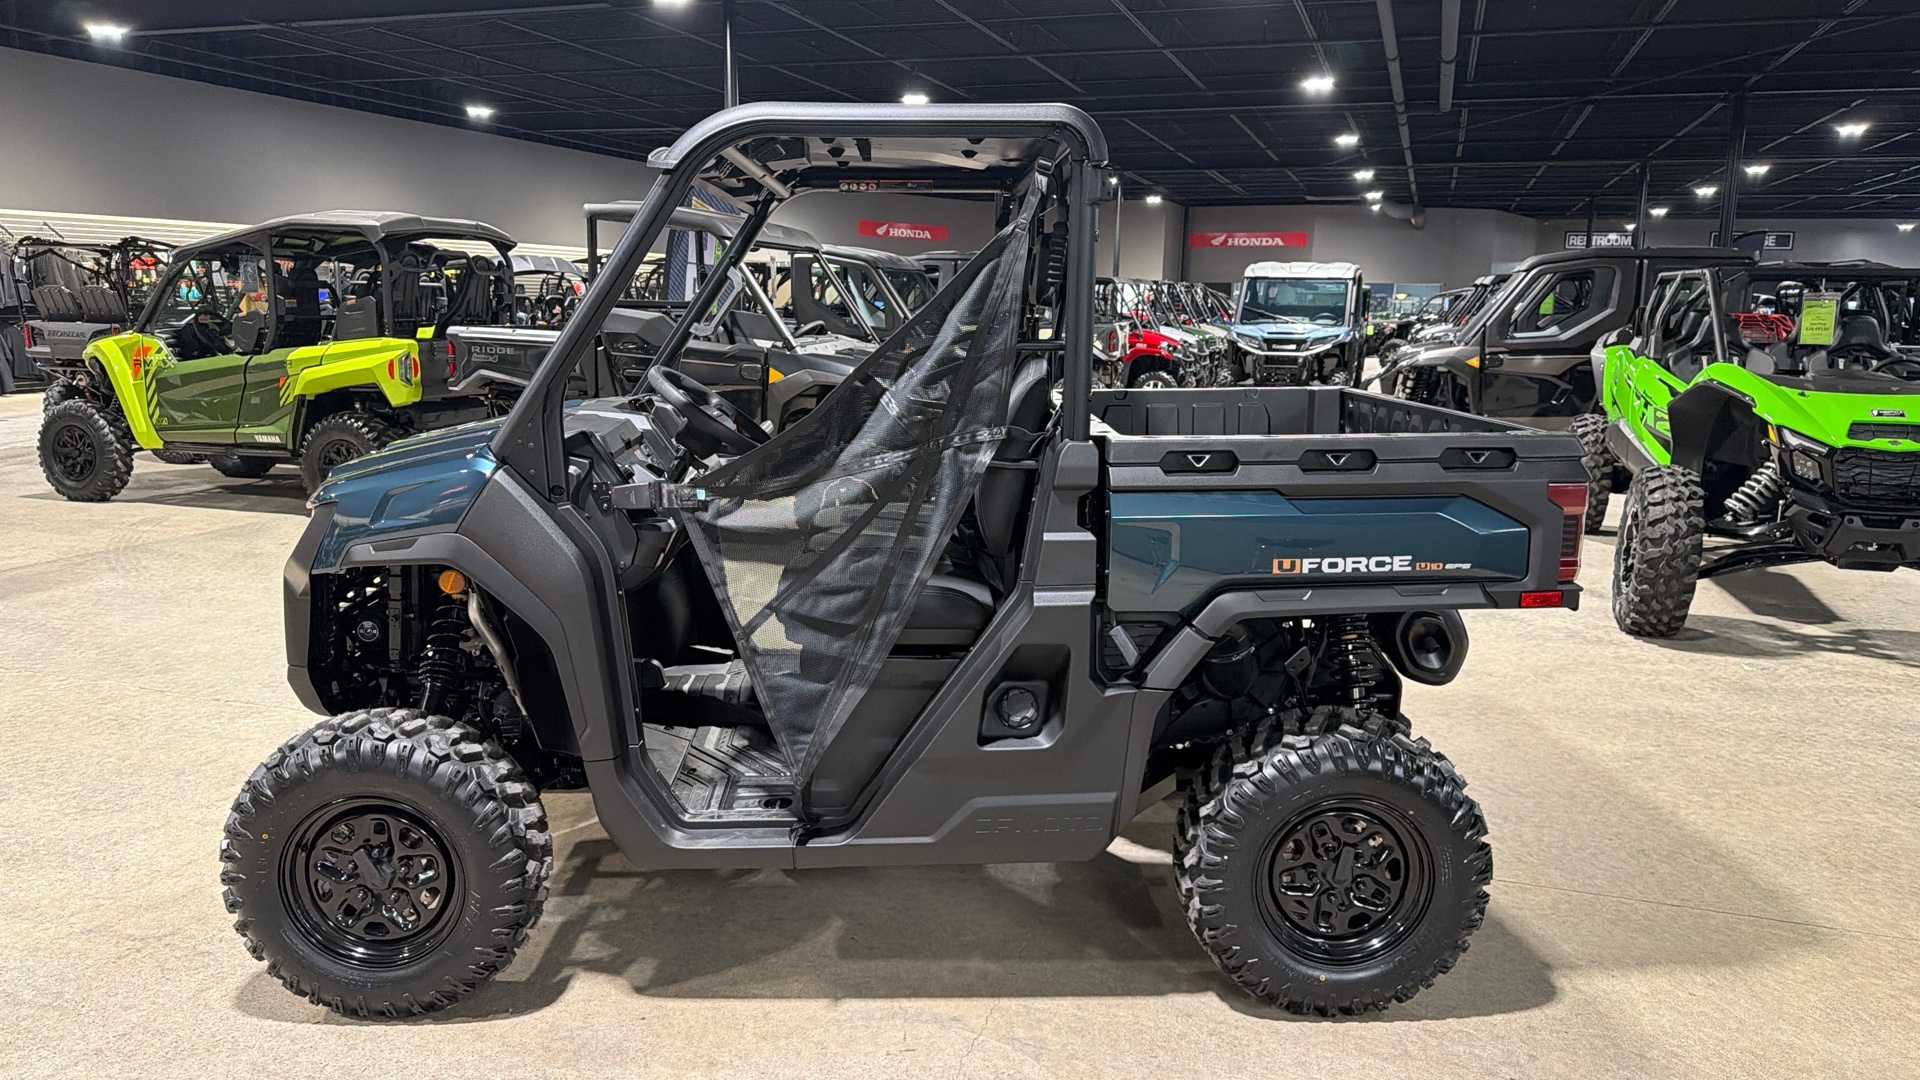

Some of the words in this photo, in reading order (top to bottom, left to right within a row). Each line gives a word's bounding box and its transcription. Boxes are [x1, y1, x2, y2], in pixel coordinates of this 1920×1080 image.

[888, 227, 932, 239] HONDA
[1226, 237, 1284, 246] HONDA
[1568, 235, 1632, 246] RETROOM
[47, 329, 87, 339] HONDA
[471, 345, 515, 354] RIDGE
[253, 434, 282, 444] YAMAHA
[1415, 562, 1444, 571] U10
